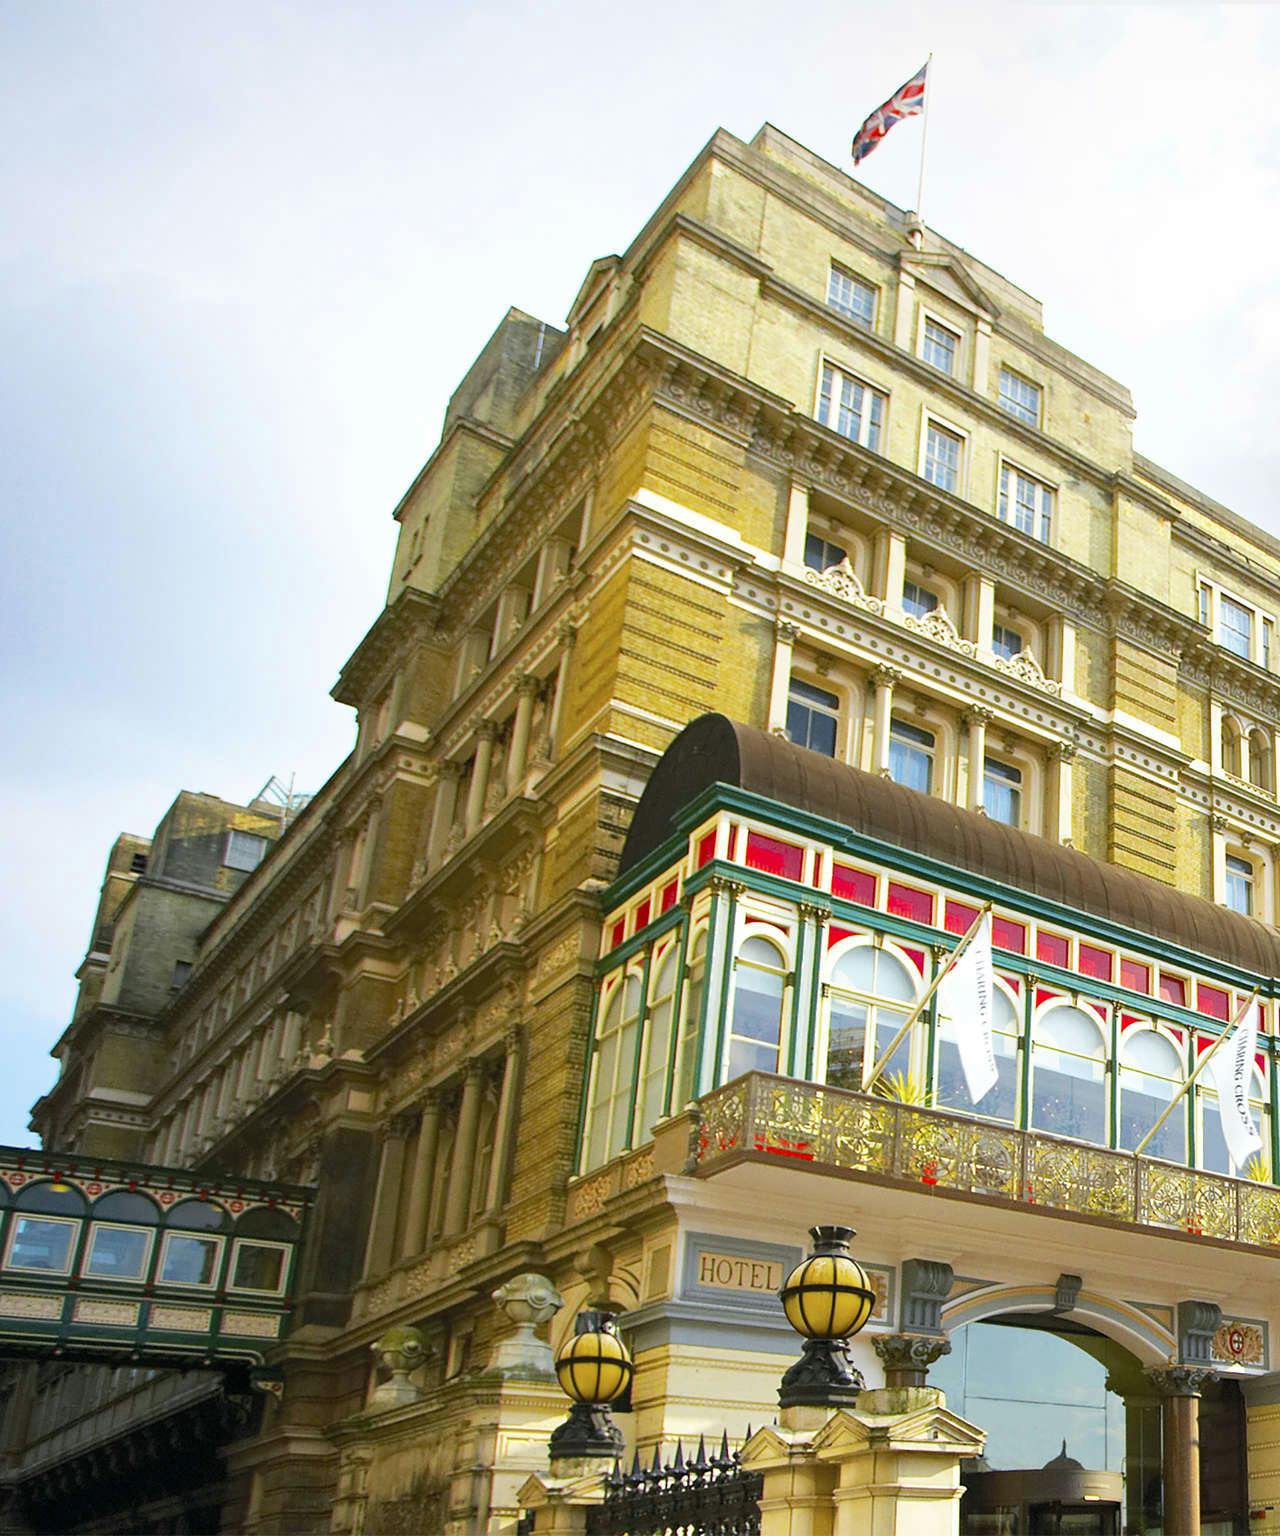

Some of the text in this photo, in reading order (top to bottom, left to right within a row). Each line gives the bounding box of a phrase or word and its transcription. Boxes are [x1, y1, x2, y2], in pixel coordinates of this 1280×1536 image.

[1234, 1029, 1255, 1137] CHARING CROSS
[700, 1256, 779, 1291] HOTEL
